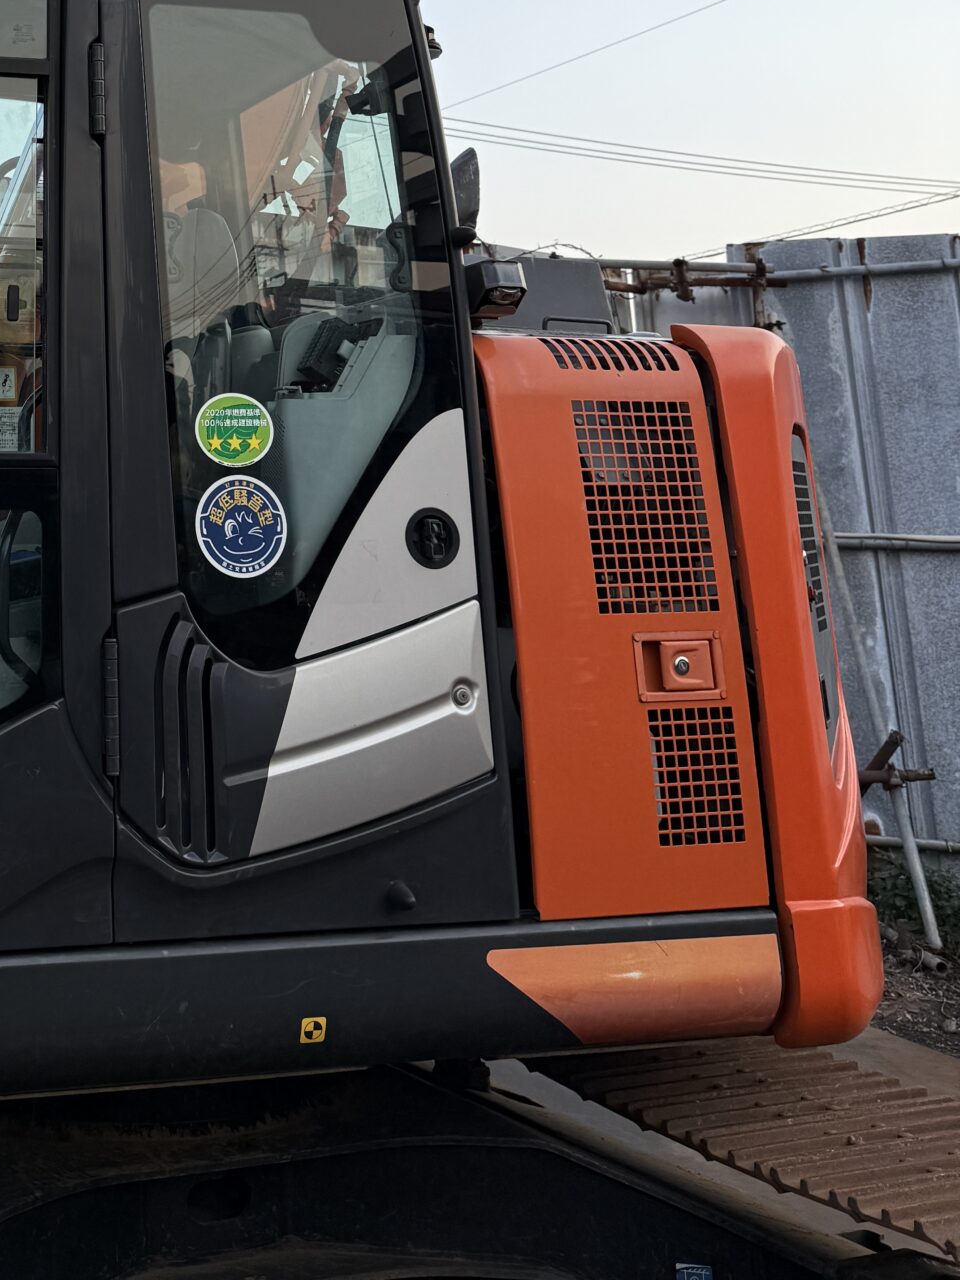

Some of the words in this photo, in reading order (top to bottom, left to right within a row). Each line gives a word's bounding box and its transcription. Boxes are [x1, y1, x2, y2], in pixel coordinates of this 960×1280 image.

[209, 489, 275, 527] 超低騒音型
